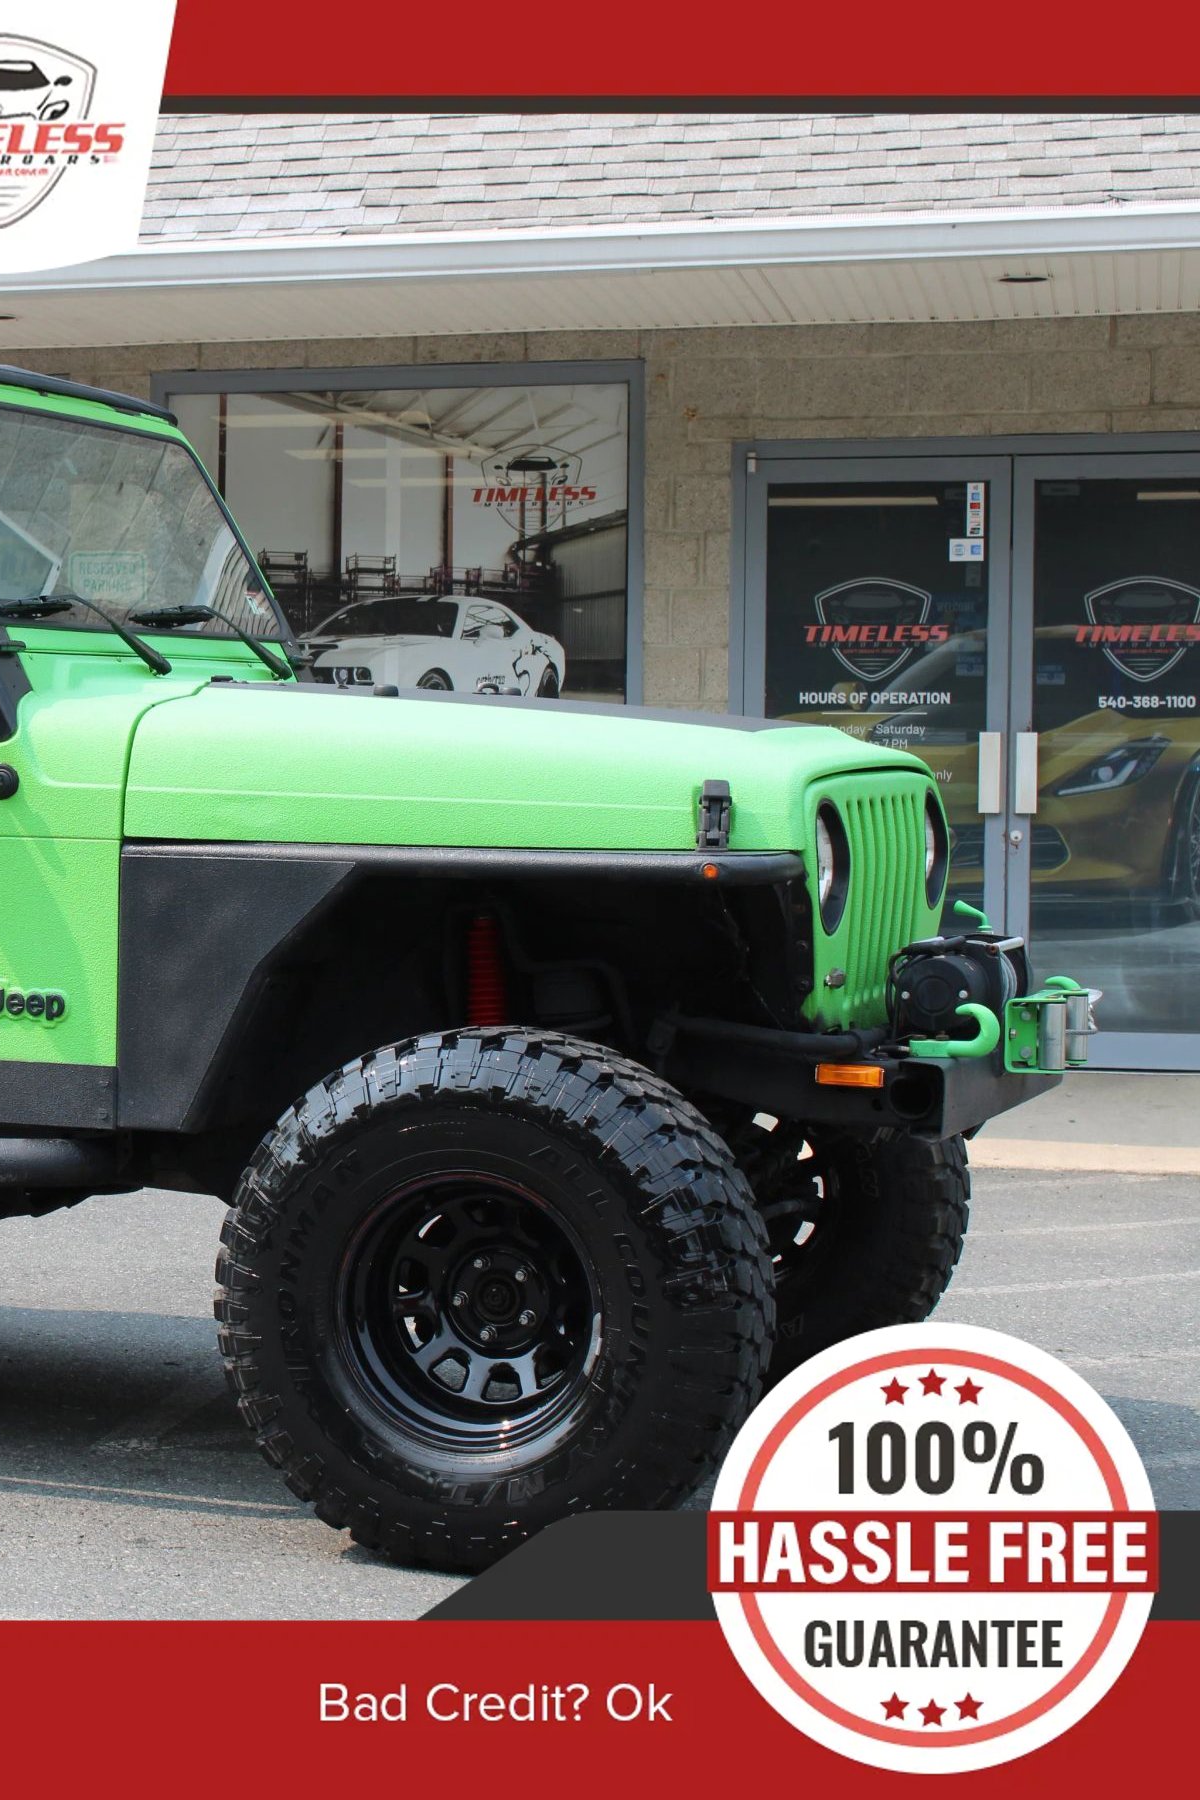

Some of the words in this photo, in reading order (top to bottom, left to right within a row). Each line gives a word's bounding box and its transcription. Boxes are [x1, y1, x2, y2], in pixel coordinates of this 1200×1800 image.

[471, 485, 598, 502] TIMELESS
[804, 624, 950, 642] TIMELESS
[1075, 624, 1200, 643] TIMELES
[799, 691, 847, 705] HOURS
[850, 691, 868, 705] OF
[870, 691, 951, 705] OPERATION
[1098, 695, 1196, 709] 540-368-1100
[823, 724, 866, 736] nday
[876, 724, 926, 736] Saturday
[882, 739, 890, 748] 7
[891, 739, 908, 750] PM
